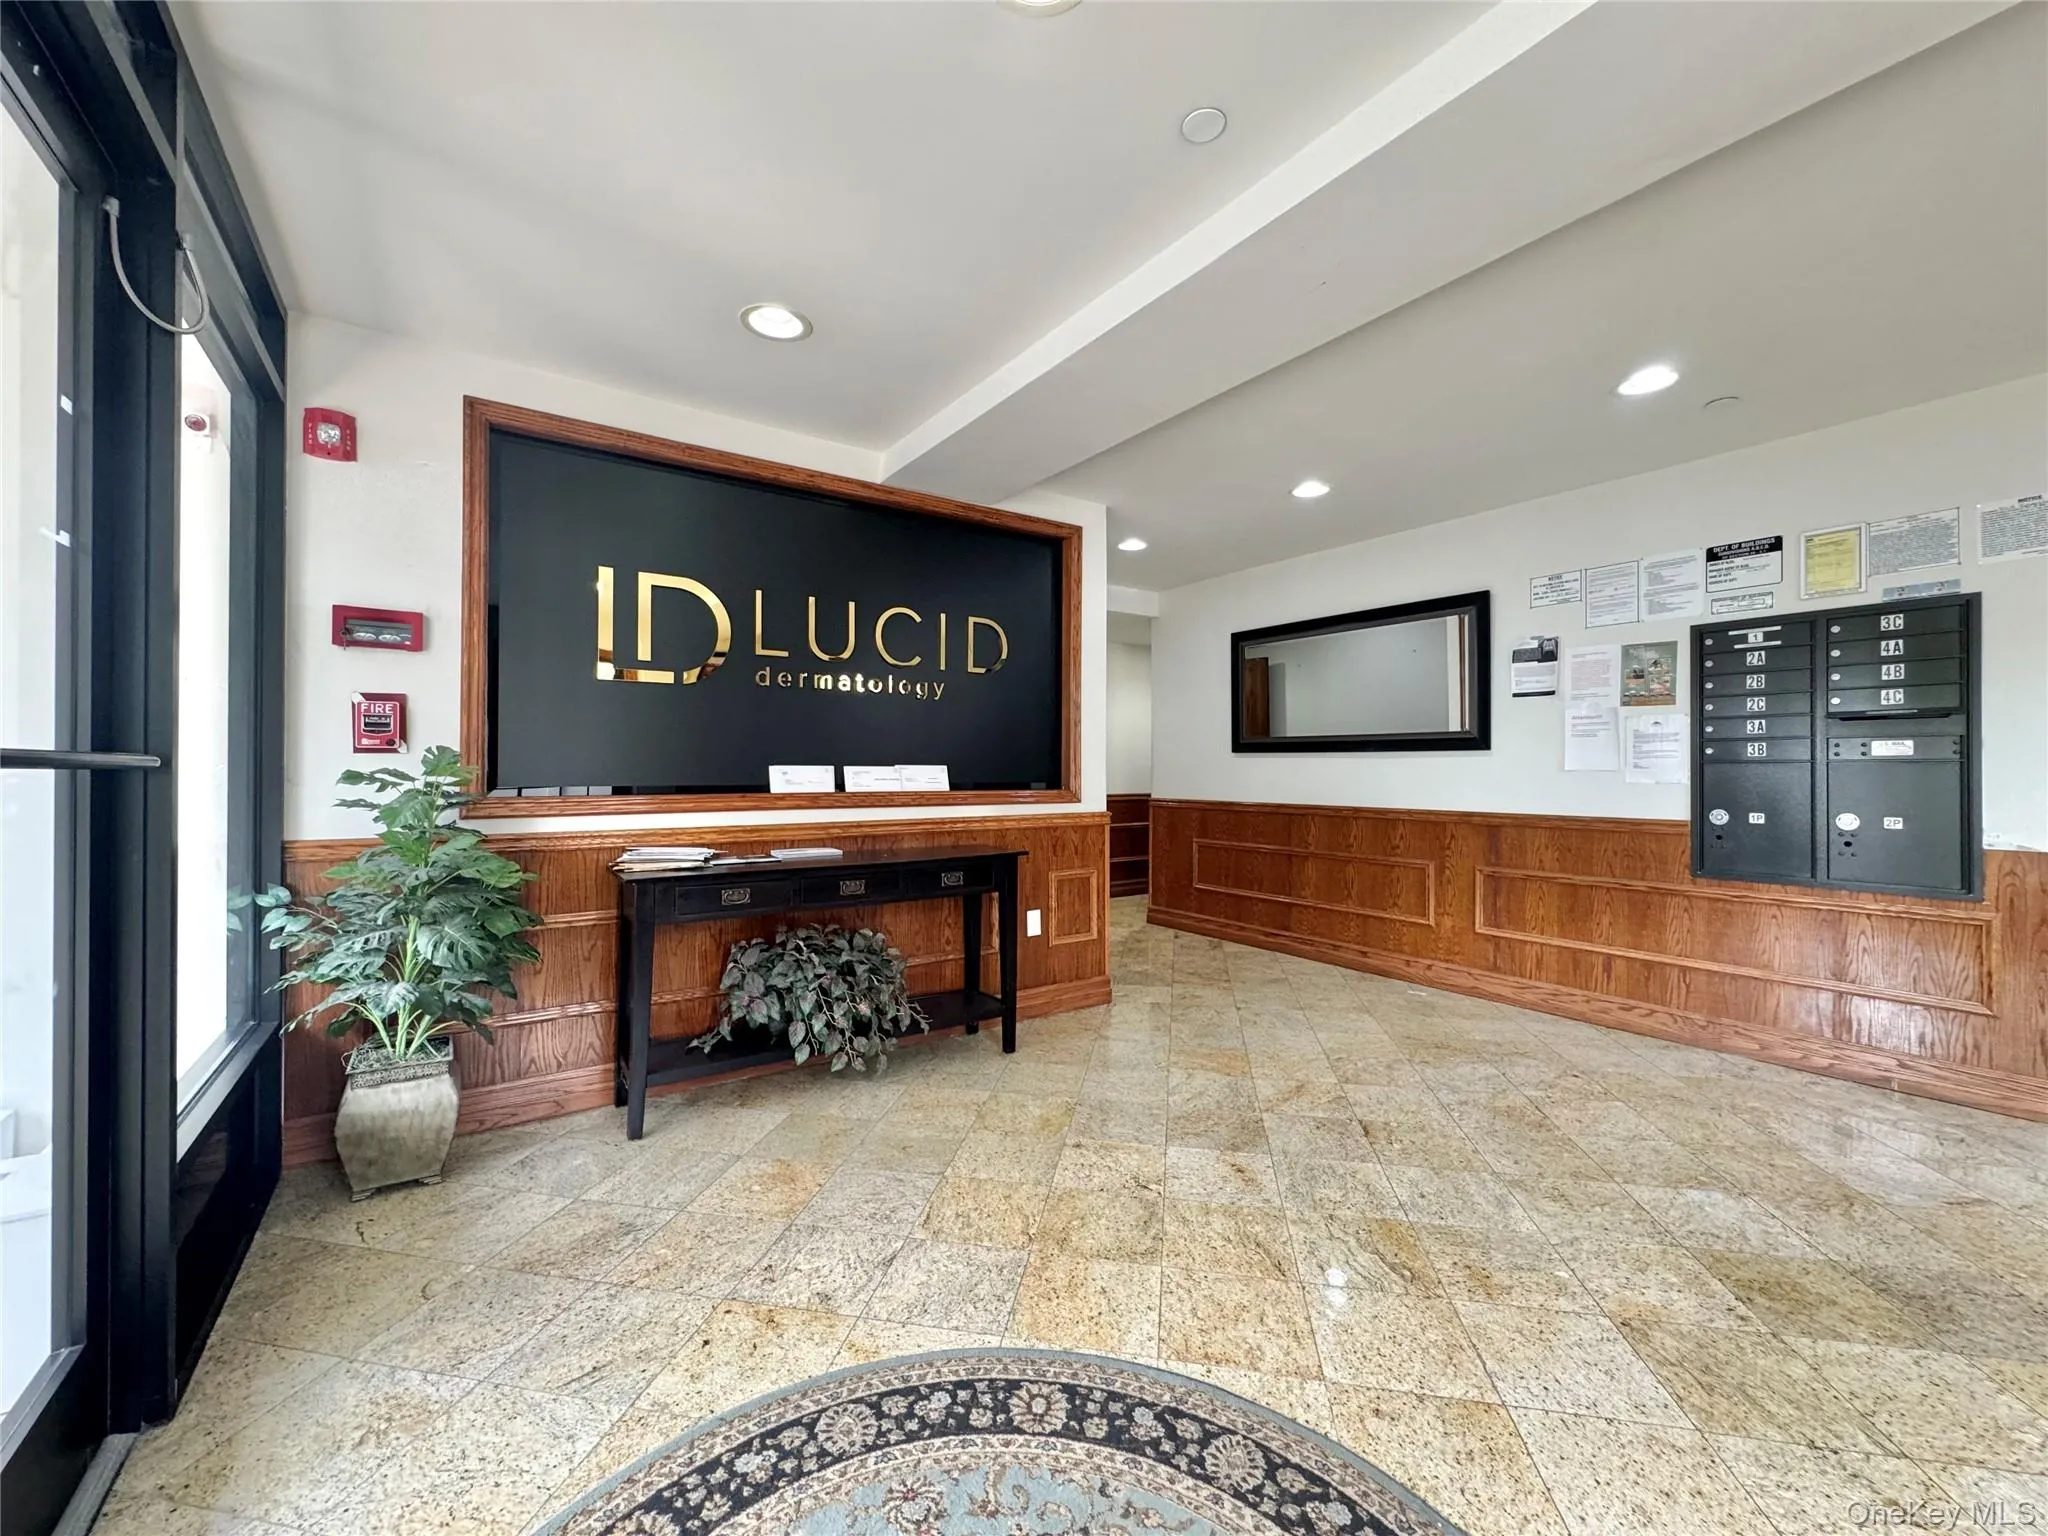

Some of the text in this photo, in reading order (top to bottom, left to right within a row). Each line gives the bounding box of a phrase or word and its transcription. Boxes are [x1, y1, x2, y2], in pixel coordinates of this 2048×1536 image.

[1741, 538, 1775, 548] BUILDINGS
[1882, 615, 1902, 630] 3C
[754, 589, 1009, 674] LUCID
[1882, 640, 1902, 655] 4A
[1748, 652, 1764, 665] 2A
[1883, 665, 1903, 679] 4B
[755, 666, 946, 700] dermatology
[1748, 676, 1763, 688] 2B
[1882, 690, 1902, 704] 4C
[361, 703, 394, 714] FIRE
[1748, 699, 1764, 711] 2C
[1748, 721, 1764, 733] 3A
[1748, 744, 1765, 756] 3B
[1751, 814, 1763, 822] 1P
[1885, 818, 1901, 827] 2P
